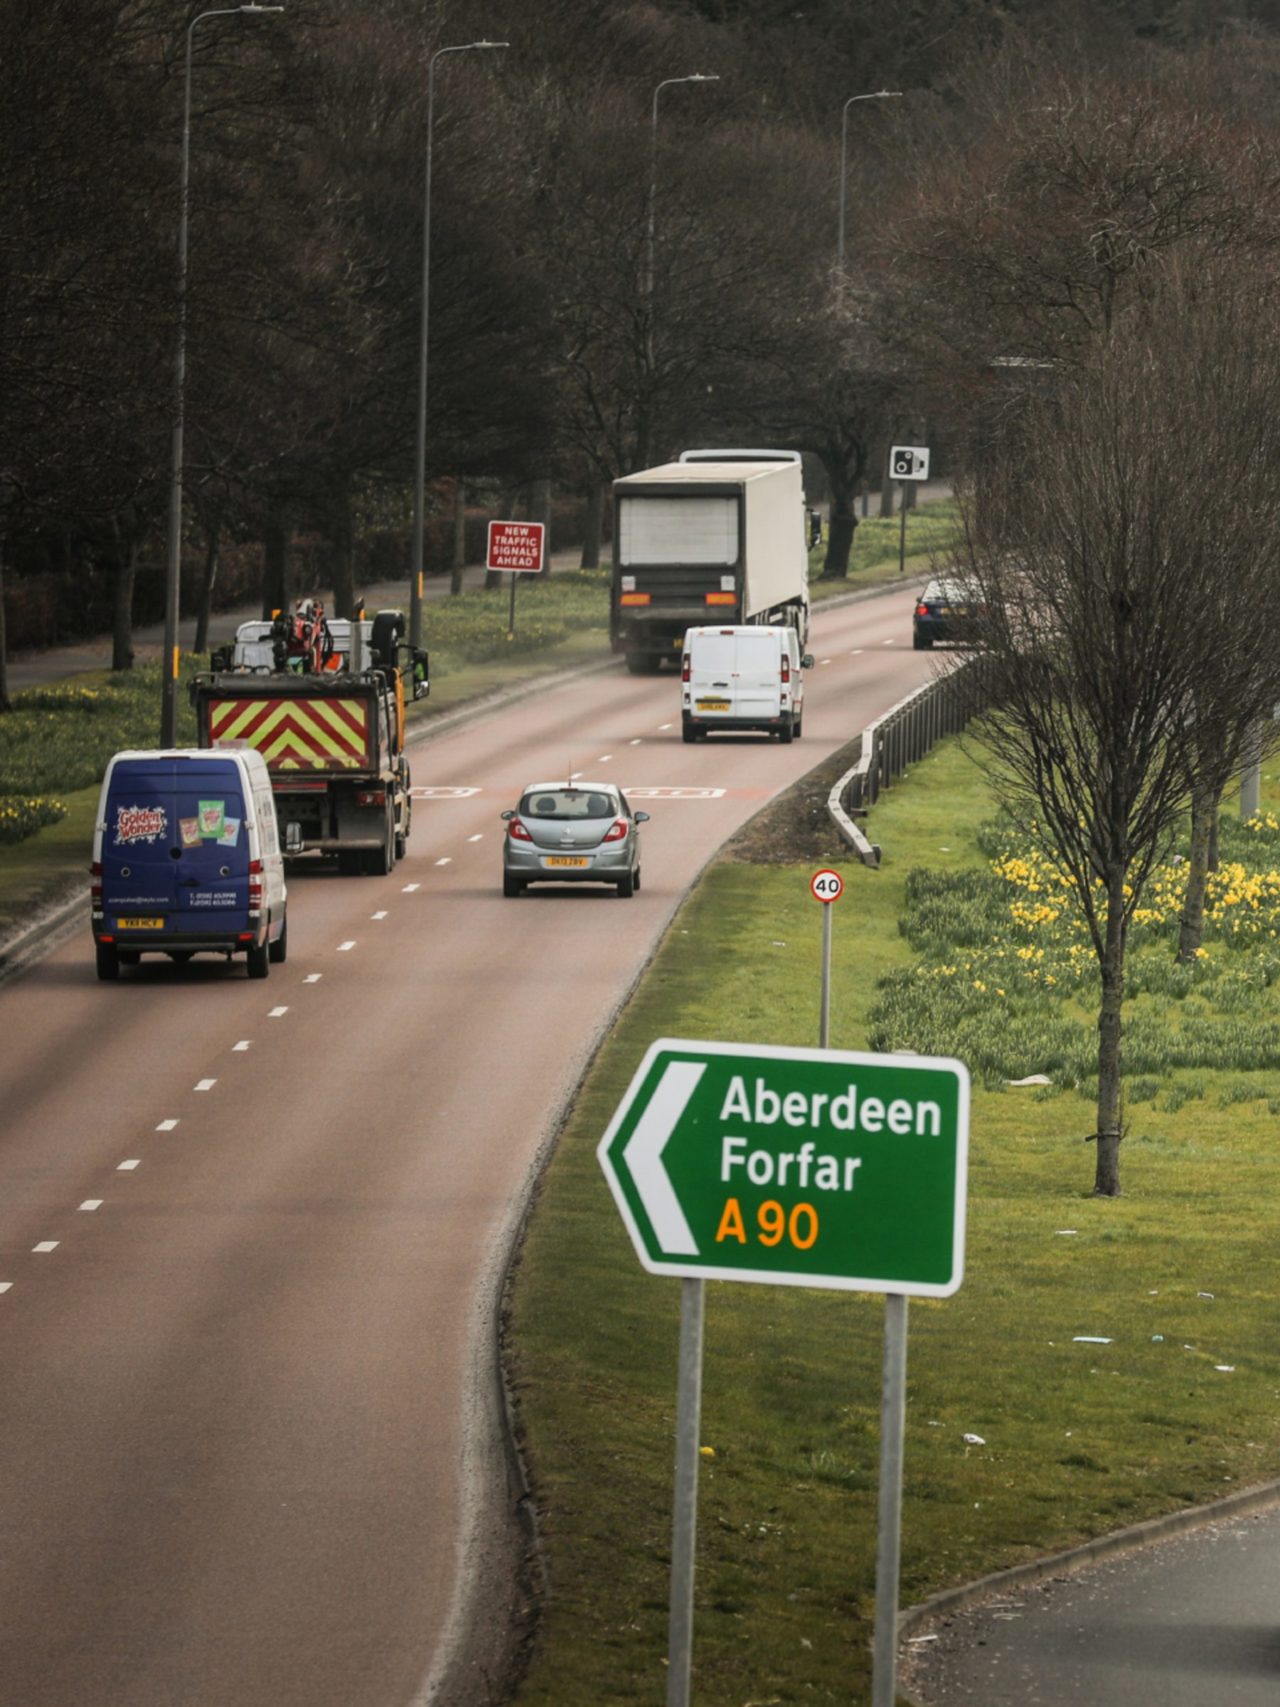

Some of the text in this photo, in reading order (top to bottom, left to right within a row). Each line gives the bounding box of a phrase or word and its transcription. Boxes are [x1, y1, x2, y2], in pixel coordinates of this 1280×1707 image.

[504, 526, 529, 536] NEW
[495, 535, 537, 547] TRAFFIC
[493, 546, 538, 557] SIGNALS
[496, 556, 533, 567] AHEAD
[120, 811, 160, 825] Golden
[120, 823, 161, 838] Wonder
[816, 880, 839, 893] 40
[719, 1075, 941, 1136] Aberdeen
[721, 1136, 862, 1191] Forfar
